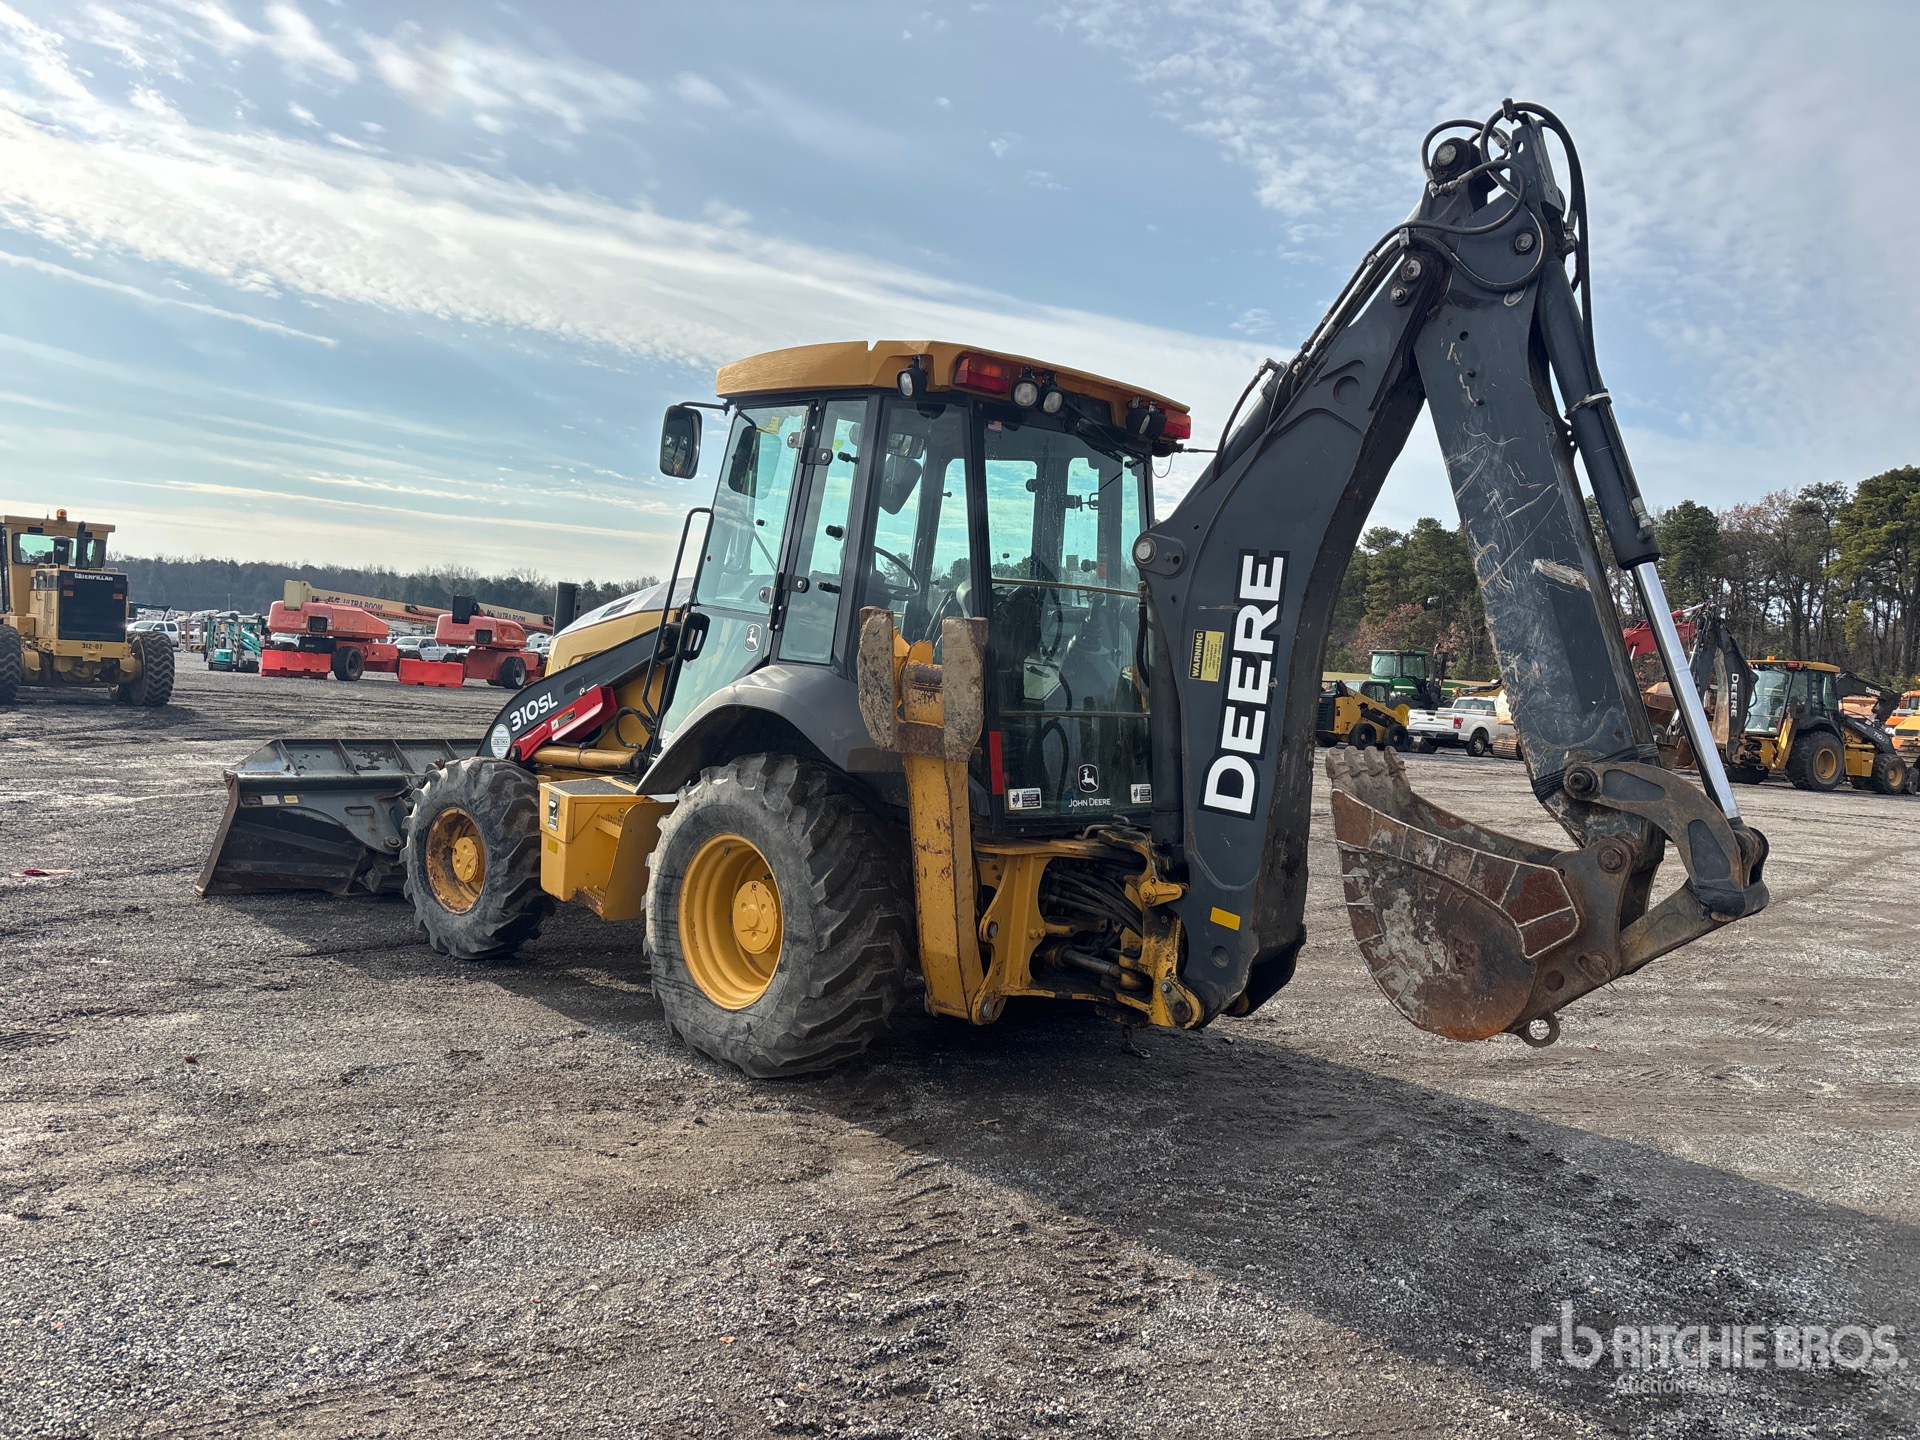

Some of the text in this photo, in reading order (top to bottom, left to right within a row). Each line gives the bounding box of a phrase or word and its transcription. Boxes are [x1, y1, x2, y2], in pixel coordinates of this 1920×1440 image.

[74, 573, 113, 581] CATERPILLAR
[364, 602, 383, 611] BOOM
[1191, 632, 1204, 677] WARNING
[1203, 555, 1284, 814] DEERE
[1730, 673, 1740, 718] DEERE
[509, 692, 558, 732] 310SL
[1068, 798, 1111, 808] JOHN DEERE
